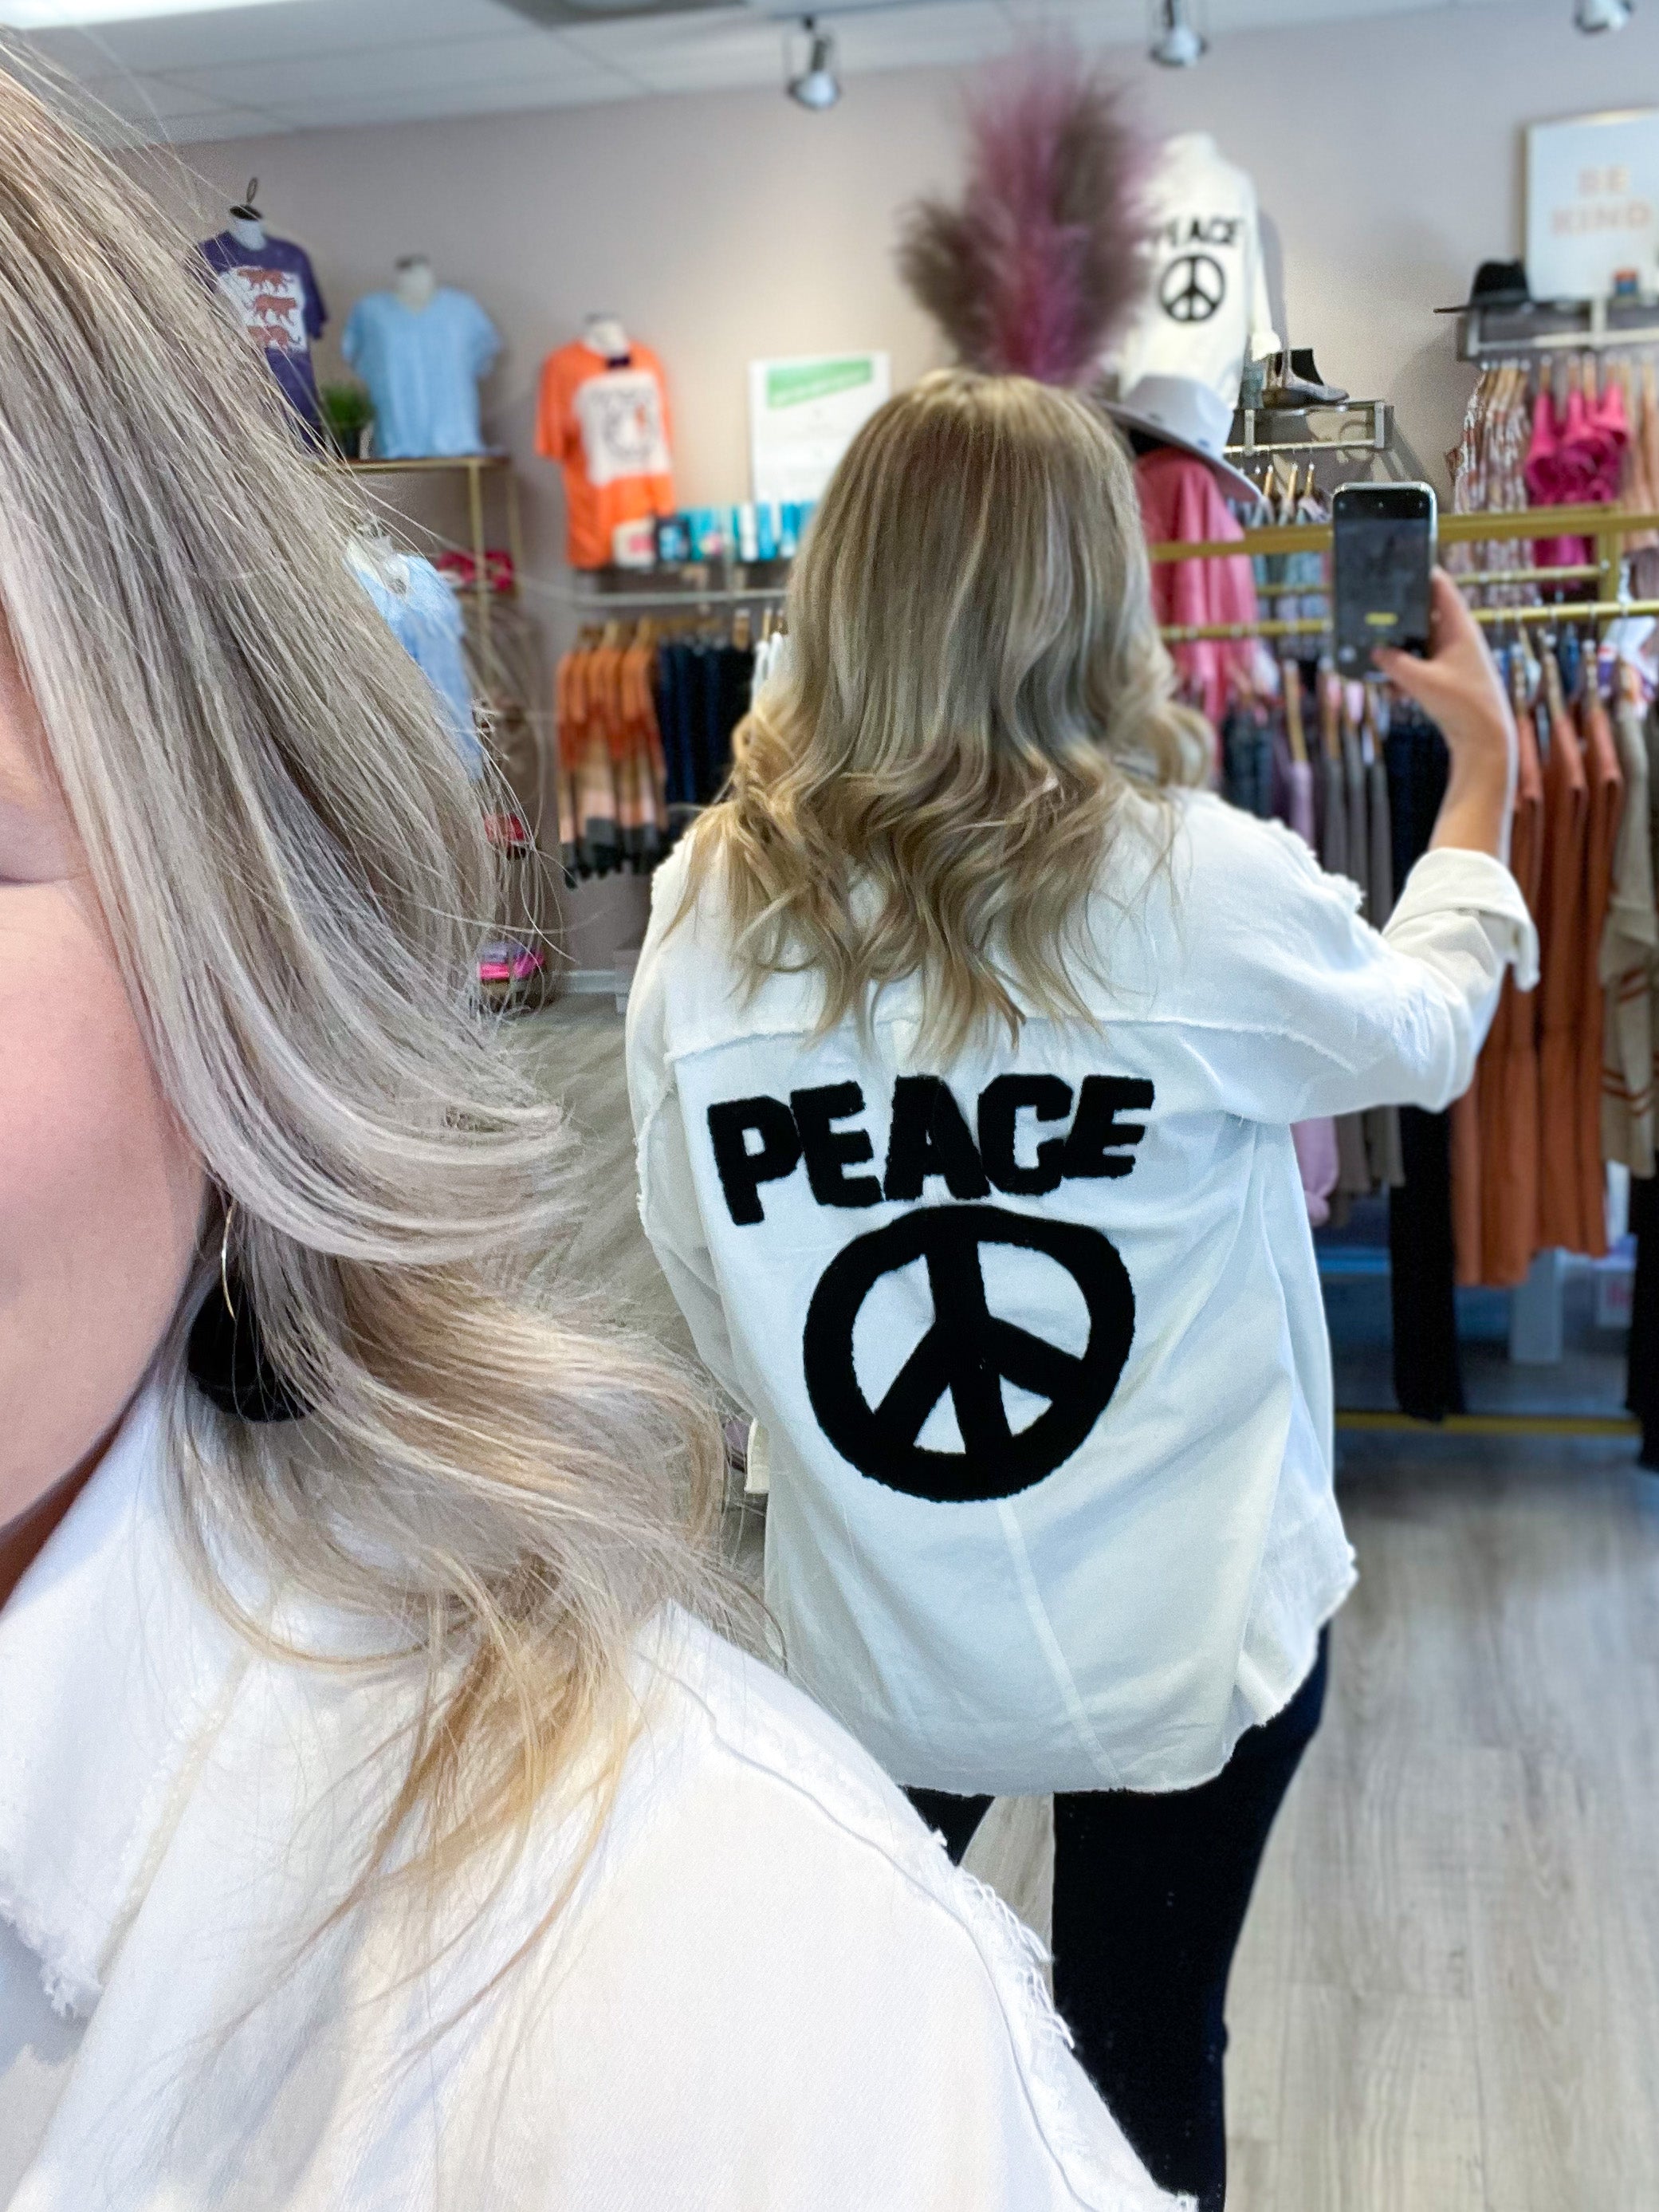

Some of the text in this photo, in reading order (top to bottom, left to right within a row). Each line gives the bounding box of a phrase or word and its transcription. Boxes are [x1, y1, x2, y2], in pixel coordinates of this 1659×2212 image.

[1578, 165, 1629, 196] BE
[1154, 216, 1242, 248] EACE
[1551, 199, 1651, 237] KIND
[706, 1073, 1155, 1226] PEACE
